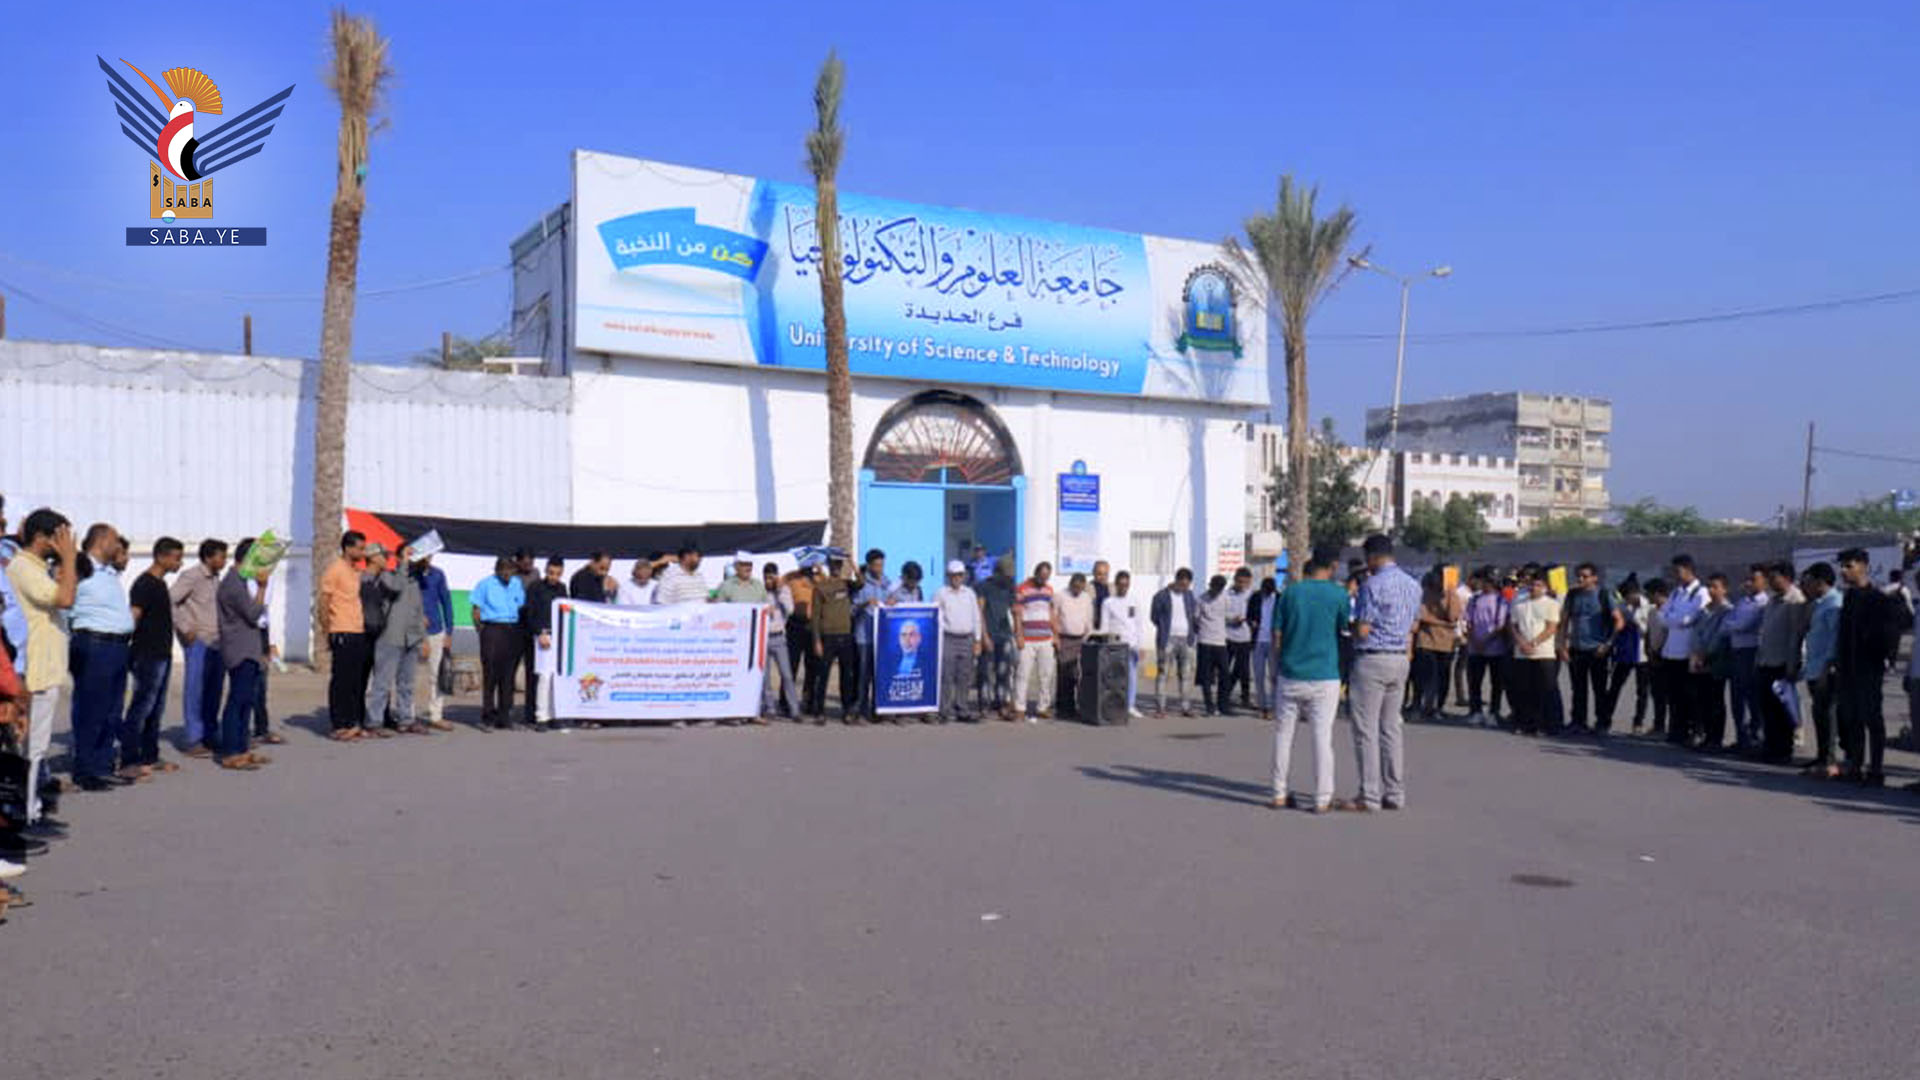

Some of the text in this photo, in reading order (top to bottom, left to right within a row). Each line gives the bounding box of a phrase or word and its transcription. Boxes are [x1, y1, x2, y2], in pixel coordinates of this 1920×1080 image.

[615, 231, 755, 268] كن من النخبة
[937, 231, 1037, 298] العلوم
[1027, 245, 1124, 304] جامعة
[904, 303, 1023, 332] فرع الحديدة
[789, 323, 1121, 379] Unirsity of Science & Technology
